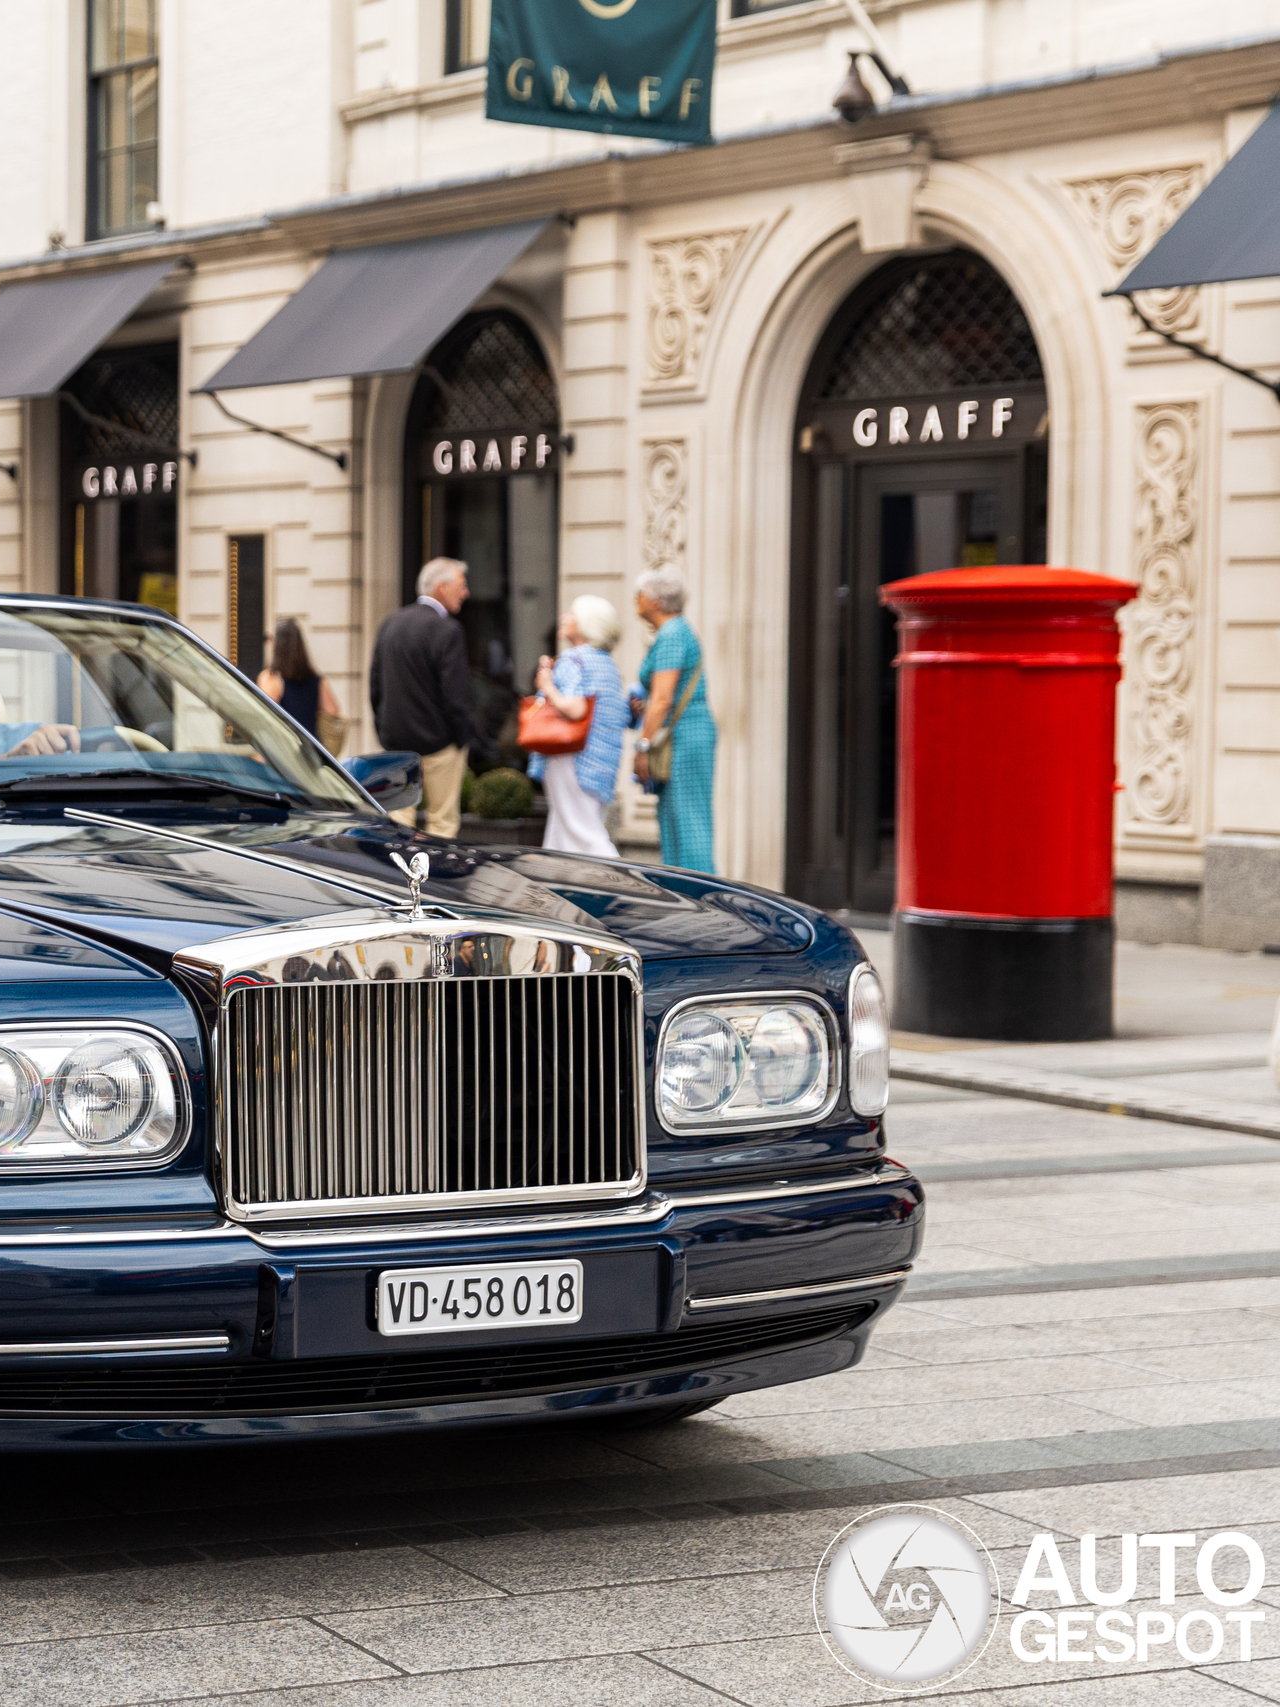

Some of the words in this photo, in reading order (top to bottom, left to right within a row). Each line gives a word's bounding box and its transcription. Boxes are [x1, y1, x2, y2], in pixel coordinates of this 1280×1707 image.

[506, 57, 704, 120] GRAFF
[852, 397, 1014, 448] GRAFF
[433, 433, 552, 475] GRAFF
[81, 460, 178, 499] GRAFF
[513, 1272, 575, 1316] 018
